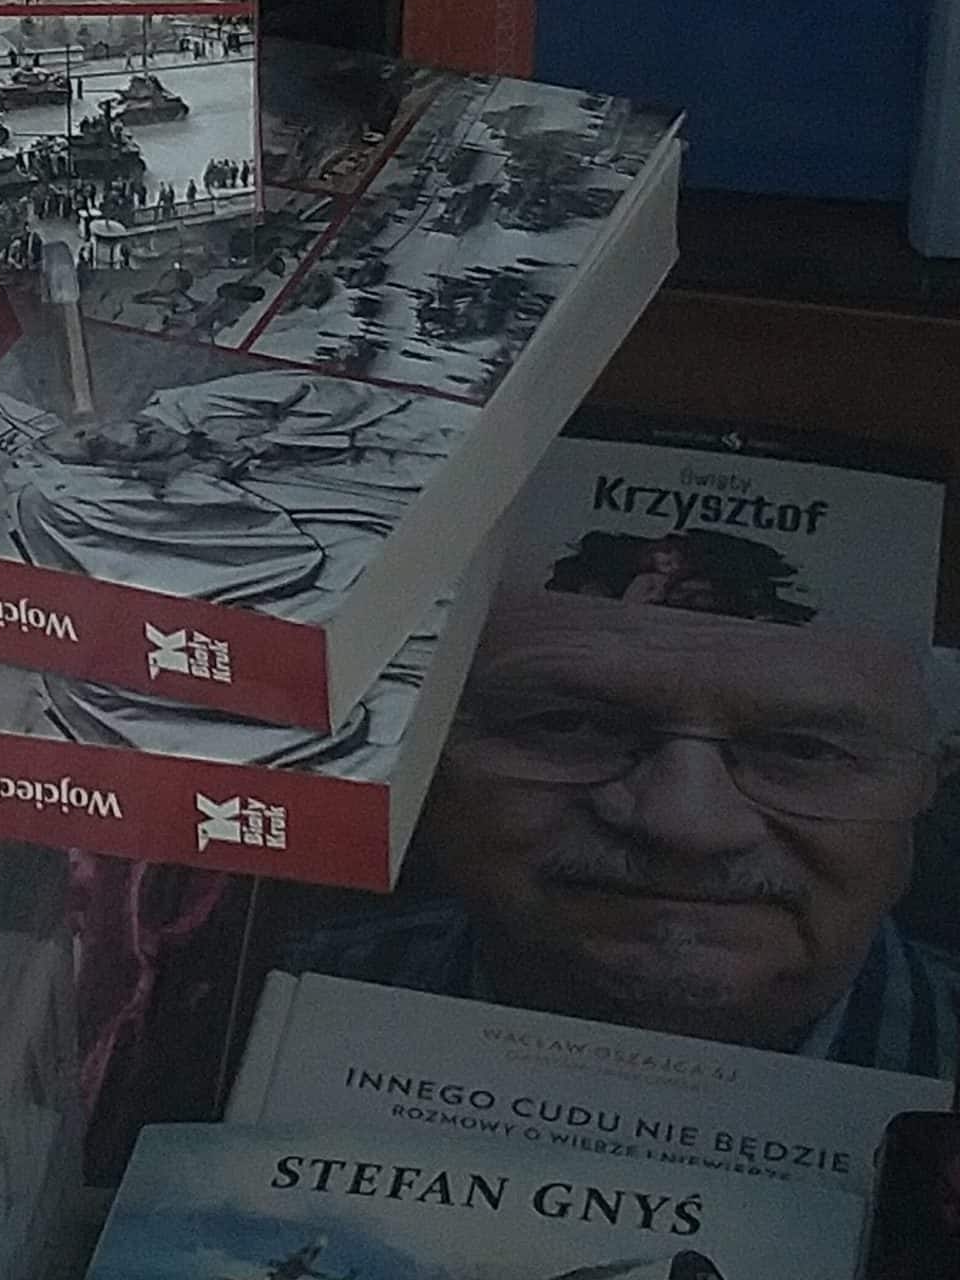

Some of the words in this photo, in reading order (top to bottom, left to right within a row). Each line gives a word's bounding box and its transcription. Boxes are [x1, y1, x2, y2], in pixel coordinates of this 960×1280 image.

[592, 474, 829, 536] Krzysztof
[344, 1066, 497, 1113] INNEGO
[511, 1095, 623, 1132] CUDU
[634, 1116, 699, 1150] NIE
[713, 1130, 851, 1176] BĘDZIE
[390, 1102, 519, 1141] ROZMOWY
[522, 1125, 542, 1143] O
[270, 1154, 511, 1212] STEFAN
[531, 1180, 705, 1238] GNYŚ
